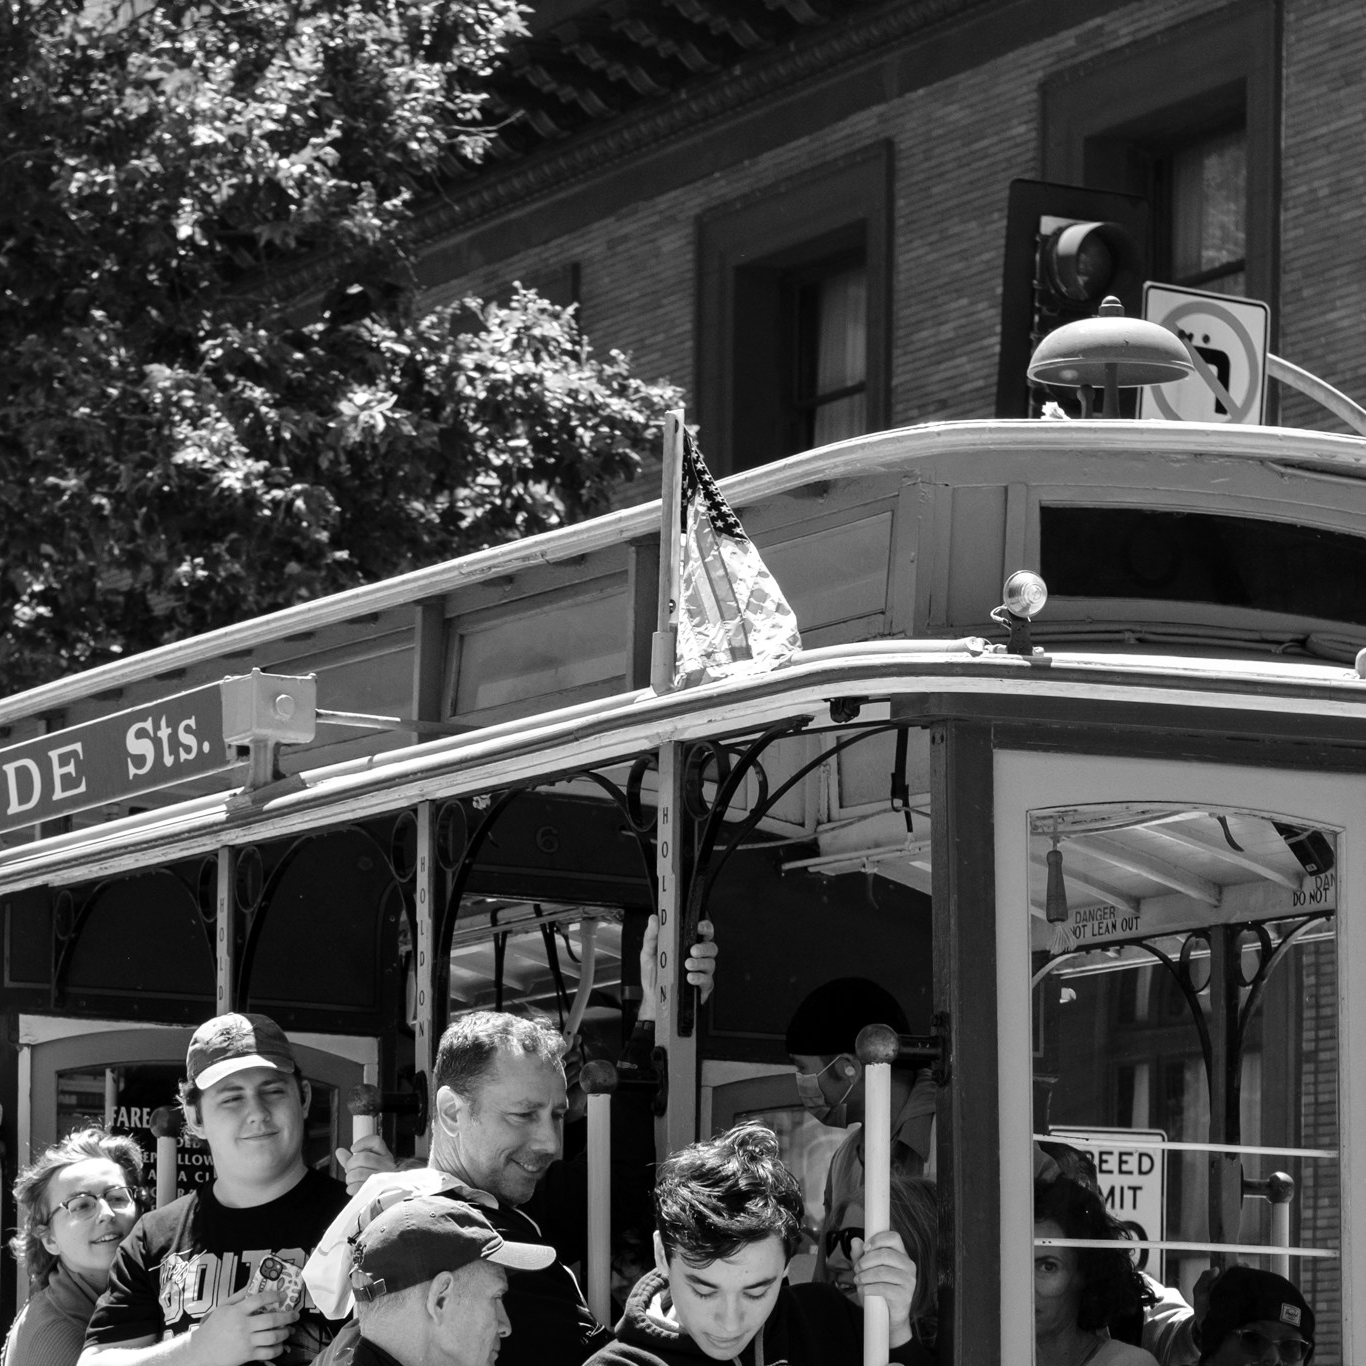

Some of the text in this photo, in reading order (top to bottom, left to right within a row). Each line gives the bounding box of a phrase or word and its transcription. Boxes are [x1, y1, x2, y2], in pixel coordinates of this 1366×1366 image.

[125, 715, 210, 782] Sts.
[536, 826, 560, 854] 6
[660, 808, 669, 1003] HOLD ON
[1293, 888, 1330, 907] DO NOT
[1075, 906, 1116, 924] DANGER
[1092, 921, 1117, 937] LEAN
[1121, 917, 1140, 932] OUT
[419, 992, 425, 1038] ON
[1087, 1150, 1155, 1175] EED
